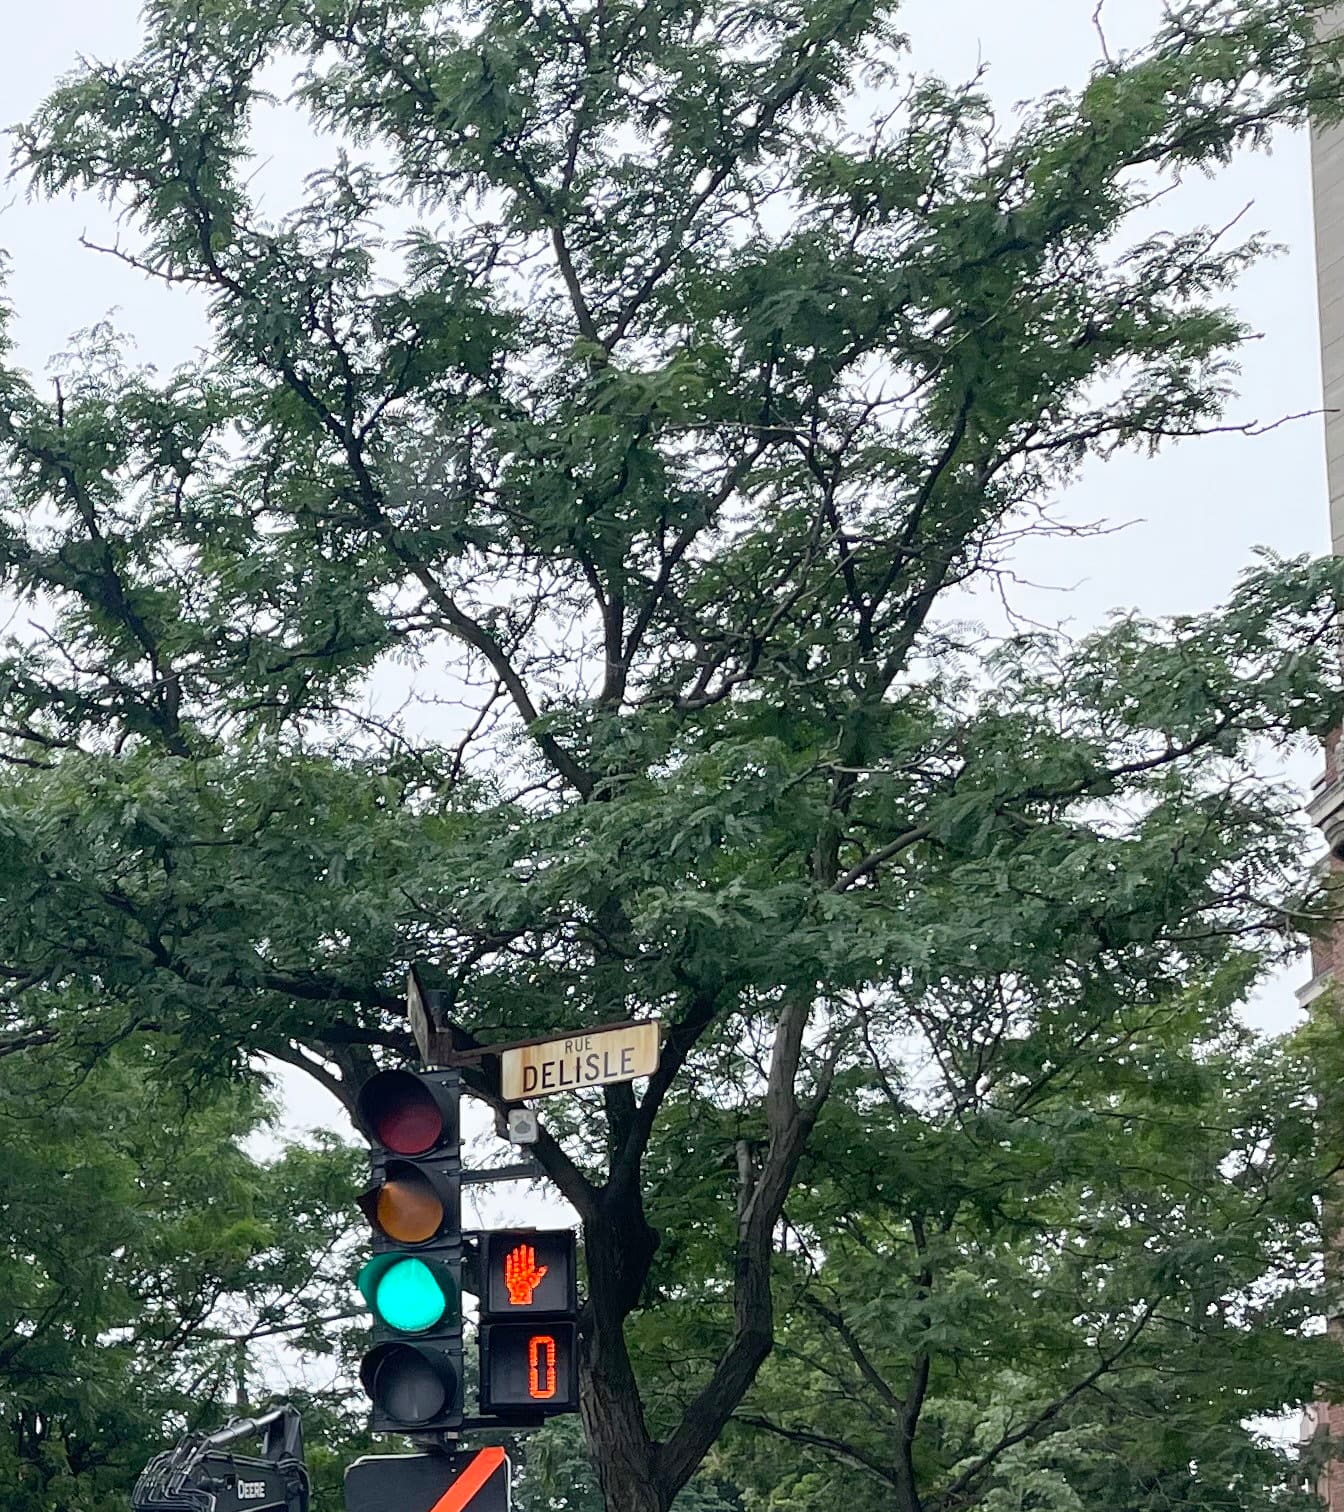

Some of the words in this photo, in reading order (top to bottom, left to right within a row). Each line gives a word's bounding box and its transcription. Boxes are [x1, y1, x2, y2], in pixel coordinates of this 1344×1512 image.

[565, 1037, 593, 1054] RUE
[523, 1047, 635, 1092] DELISLE
[529, 1335, 556, 1399] 0
[238, 1479, 265, 1499] DEERE
